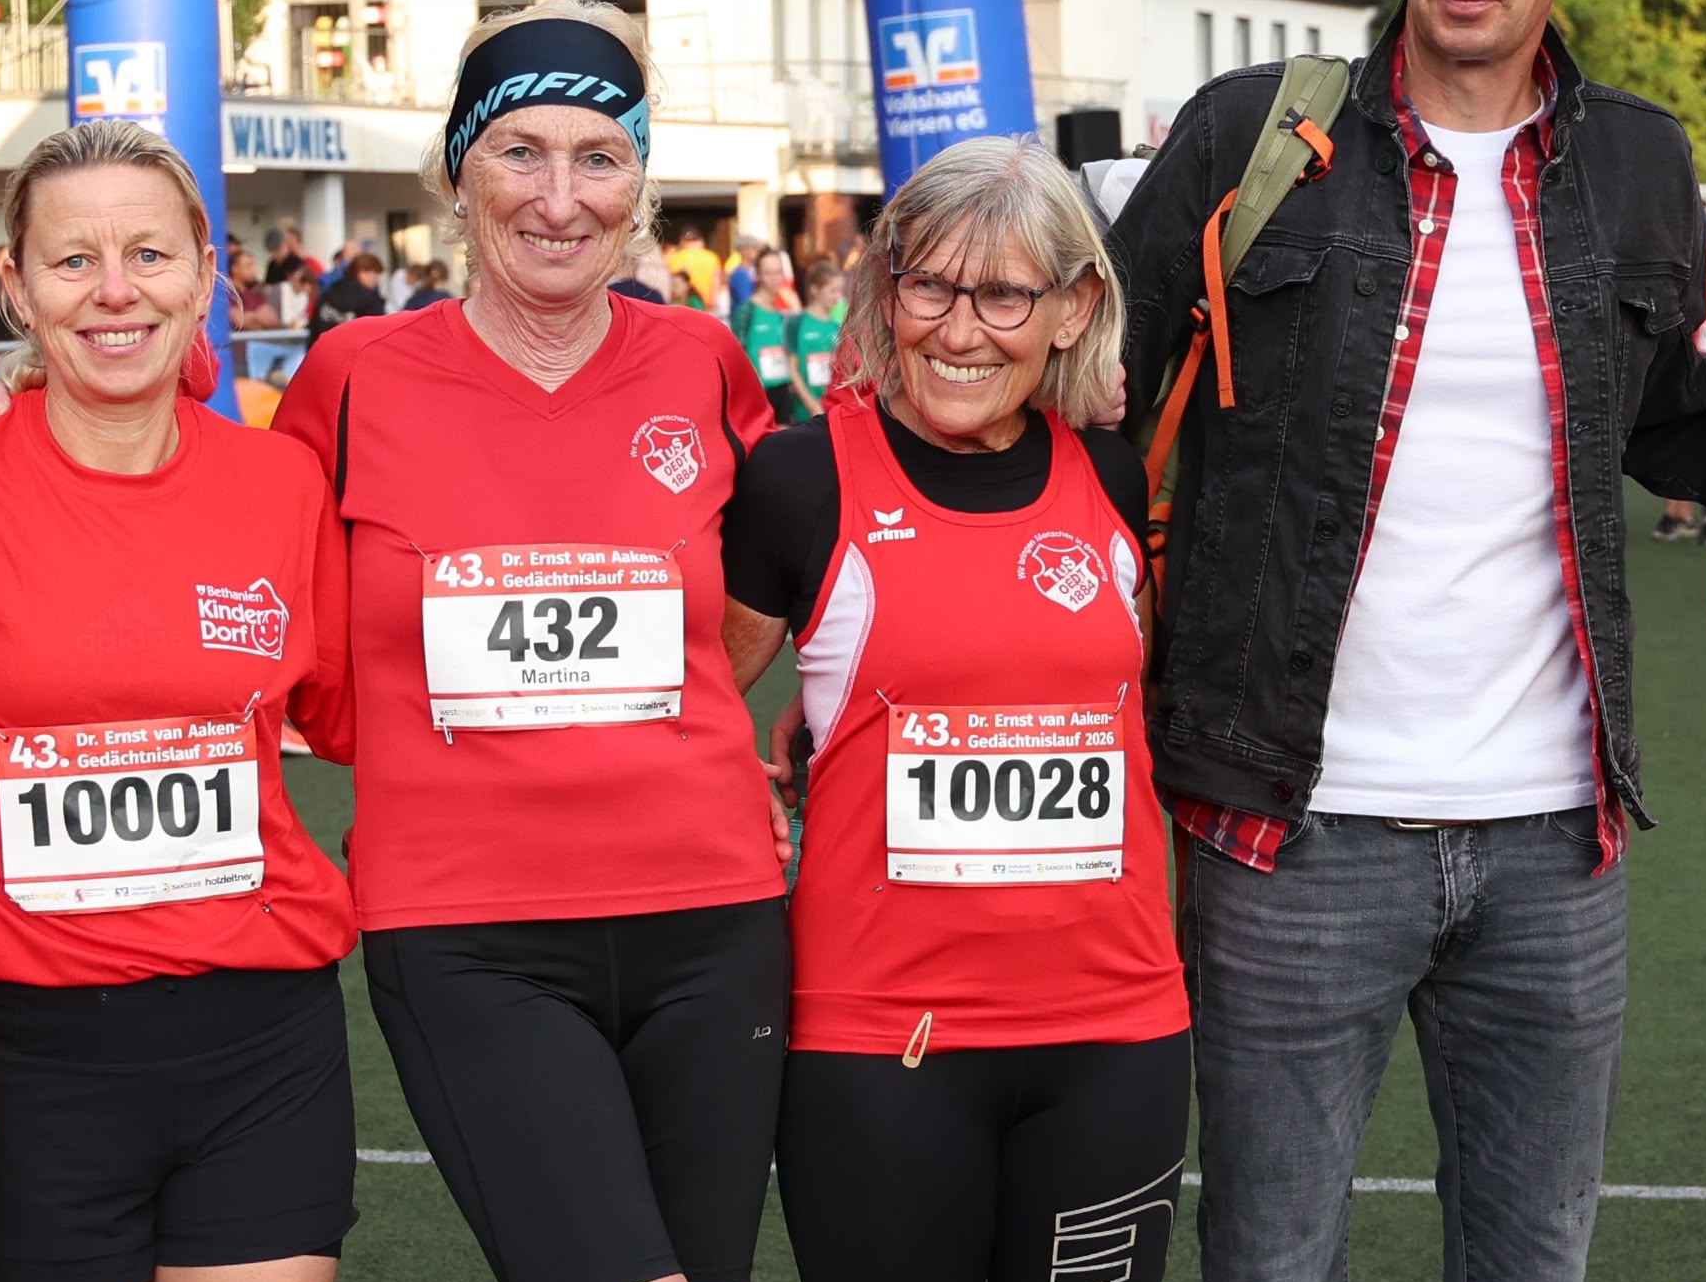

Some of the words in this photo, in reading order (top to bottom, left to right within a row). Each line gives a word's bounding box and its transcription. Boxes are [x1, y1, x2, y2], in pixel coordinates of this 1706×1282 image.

[883, 86, 980, 115] Volksbank
[449, 72, 627, 177] DYNAFIT
[885, 113, 953, 138] Viersen
[955, 108, 987, 130] eG
[230, 115, 346, 160] WALDNIEL
[664, 452, 688, 476] OEDT
[672, 464, 695, 487] 1884
[867, 527, 916, 544] erima
[1034, 530, 1074, 542] Menschen
[434, 553, 495, 588] 43.
[502, 552, 524, 567] Dr.
[529, 551, 571, 566] Ernst
[577, 552, 605, 564] van
[611, 550, 663, 564] Aaken-
[502, 569, 624, 588] Gedächtnislauf
[630, 569, 669, 584] 2026
[1059, 569, 1086, 595] OEDT
[207, 585, 264, 602] Bethanien
[1070, 579, 1095, 605] 1884
[198, 598, 264, 625] Kinder
[200, 620, 248, 644] Dorf
[487, 596, 619, 662] 432
[521, 668, 591, 685] Martina
[624, 700, 670, 712] holzleitner
[968, 714, 989, 728] Dr.
[995, 713, 1034, 727] Ernst
[1038, 714, 1065, 726] van
[1070, 710, 1114, 726] Aaken-
[76, 732, 99, 747] Dr.
[105, 729, 147, 745] Ernst
[154, 728, 182, 741] van
[188, 721, 241, 738] Aaken-
[901, 712, 961, 747] 43.
[967, 732, 1081, 748] Gedächtnislauf
[1085, 731, 1114, 746] 2026
[9, 734, 70, 769] 43.
[77, 743, 201, 769] Gedächtnislauf
[207, 741, 244, 758] 2026
[907, 757, 1111, 822] 10028
[18, 767, 232, 847] 10001
[1075, 860, 1114, 870] holzleitner
[205, 872, 253, 886] holzleitner
